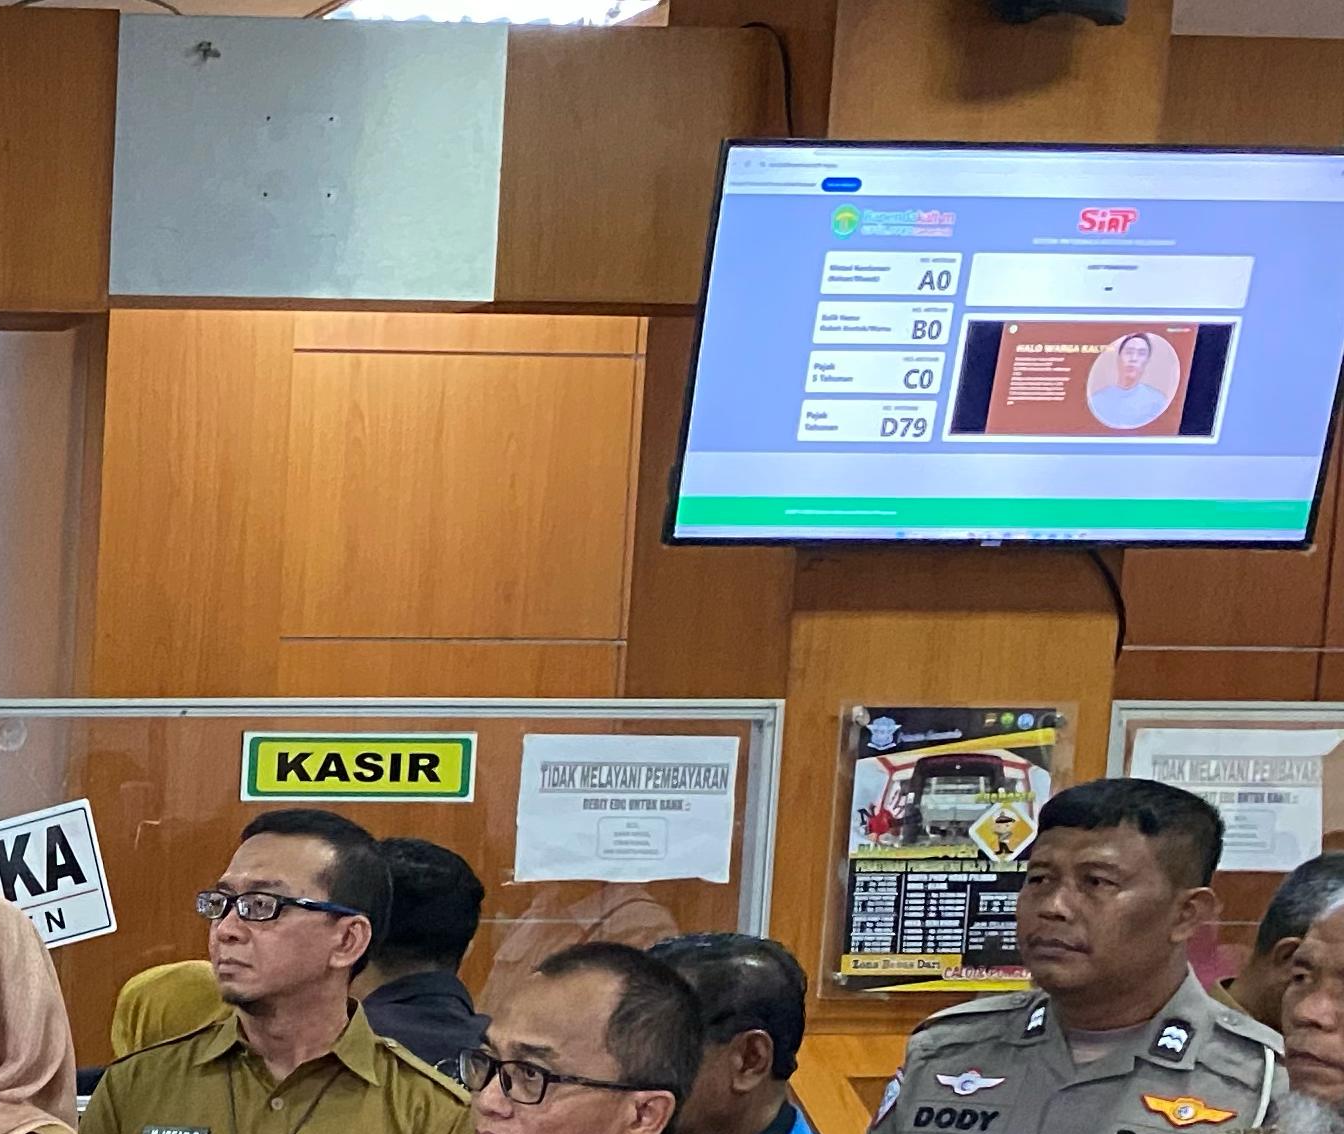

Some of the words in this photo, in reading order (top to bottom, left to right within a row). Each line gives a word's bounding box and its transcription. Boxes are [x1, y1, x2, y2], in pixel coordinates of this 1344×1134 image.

[917, 270, 952, 291] A0
[912, 319, 942, 340] B0
[903, 369, 934, 389] C0
[880, 417, 928, 438] D79
[276, 751, 441, 783] KASIR
[540, 764, 578, 789] TIDAK
[580, 765, 642, 789] MELAYANI
[644, 766, 729, 790] PEMBAYARAN
[914, 1106, 999, 1131] DODY
